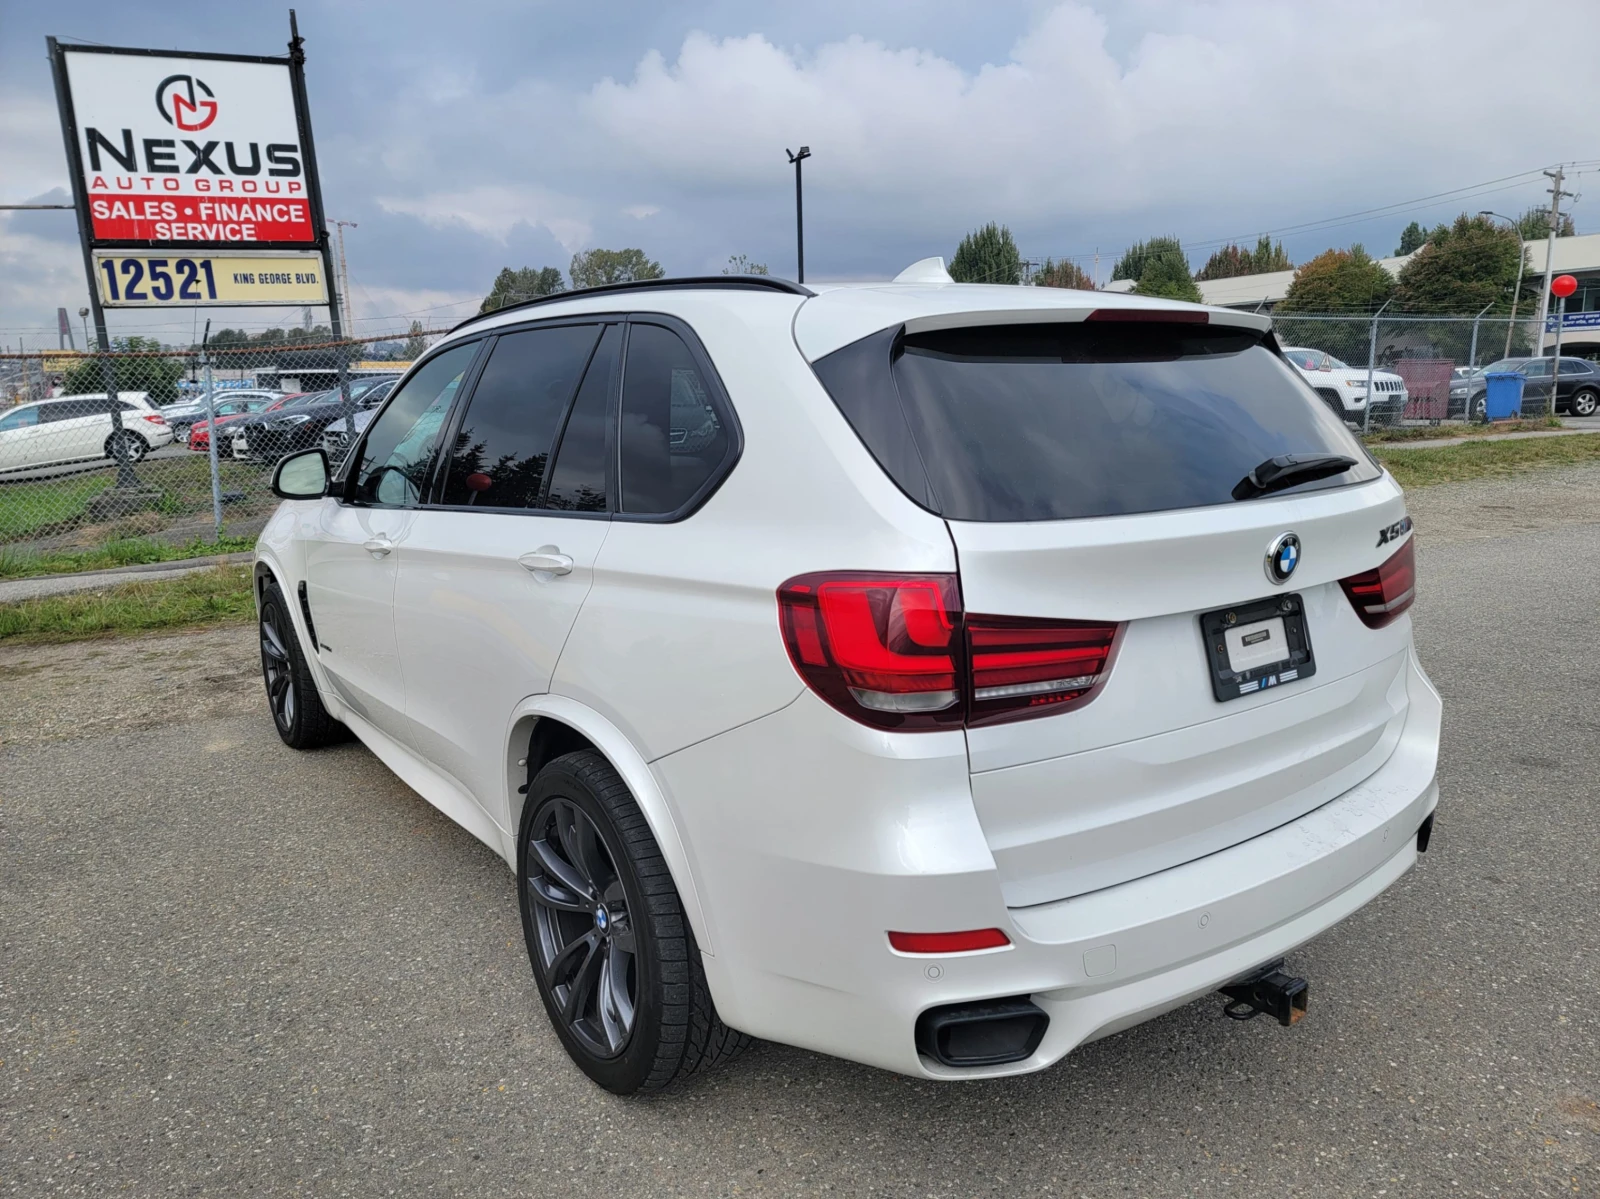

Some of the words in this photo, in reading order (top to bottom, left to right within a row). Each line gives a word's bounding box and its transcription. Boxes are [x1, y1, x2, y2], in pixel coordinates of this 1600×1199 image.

[85, 127, 302, 178] NEXUS
[92, 175, 180, 192] AUTO
[195, 178, 302, 194] GROUP
[93, 200, 178, 221] SALES
[200, 202, 306, 223] FINANCE
[155, 222, 257, 242] SERVICE
[101, 258, 218, 301] 12521
[233, 272, 255, 285] KING
[259, 272, 293, 285] GEORGE
[296, 273, 319, 285] BLVD.
